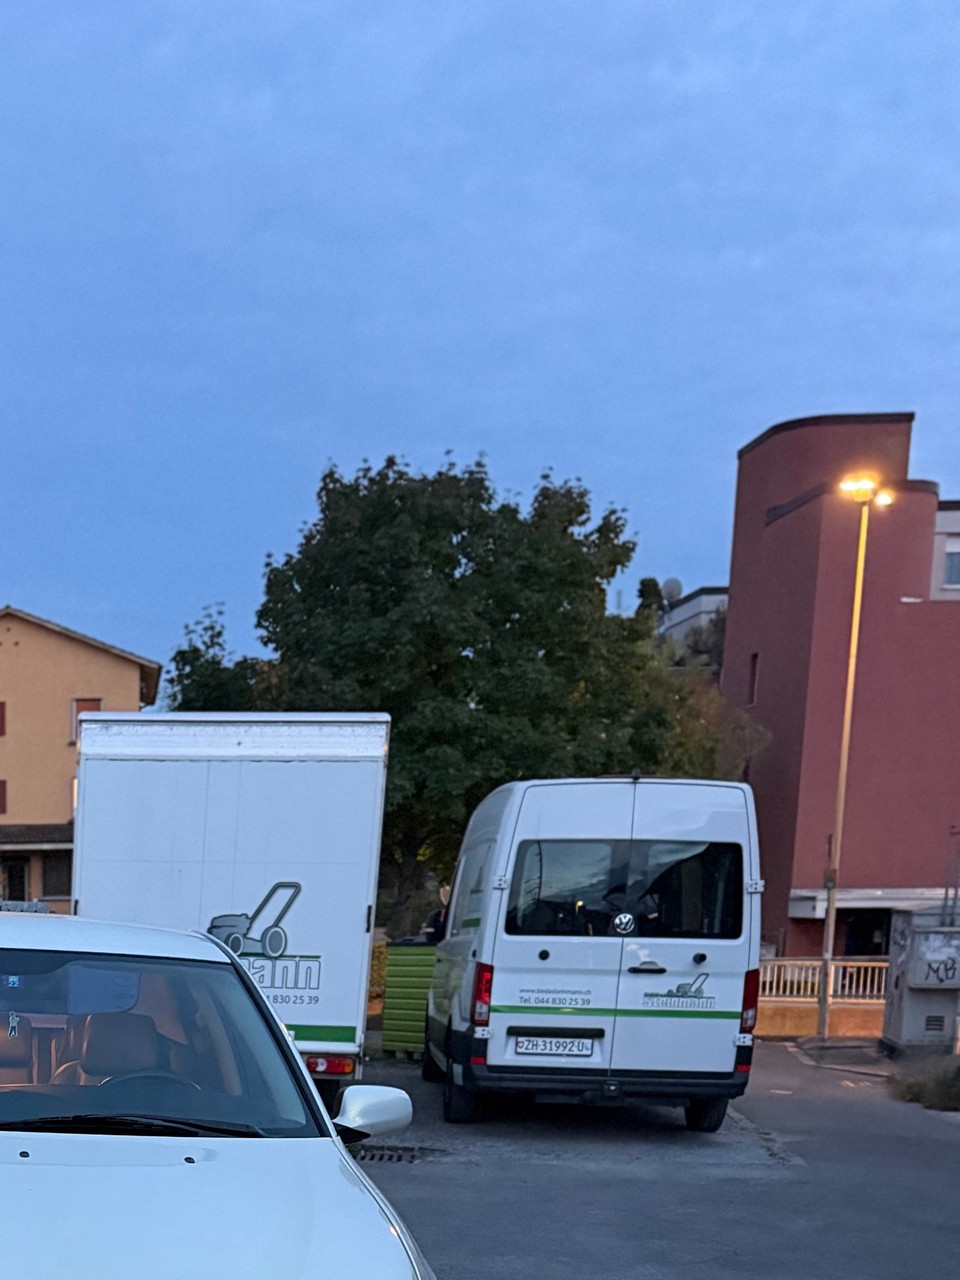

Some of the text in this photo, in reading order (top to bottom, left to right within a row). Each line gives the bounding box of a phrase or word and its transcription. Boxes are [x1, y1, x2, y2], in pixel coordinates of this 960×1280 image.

[272, 995, 290, 1004] 830
[292, 995, 304, 1004] 25
[306, 996, 319, 1005] 39
